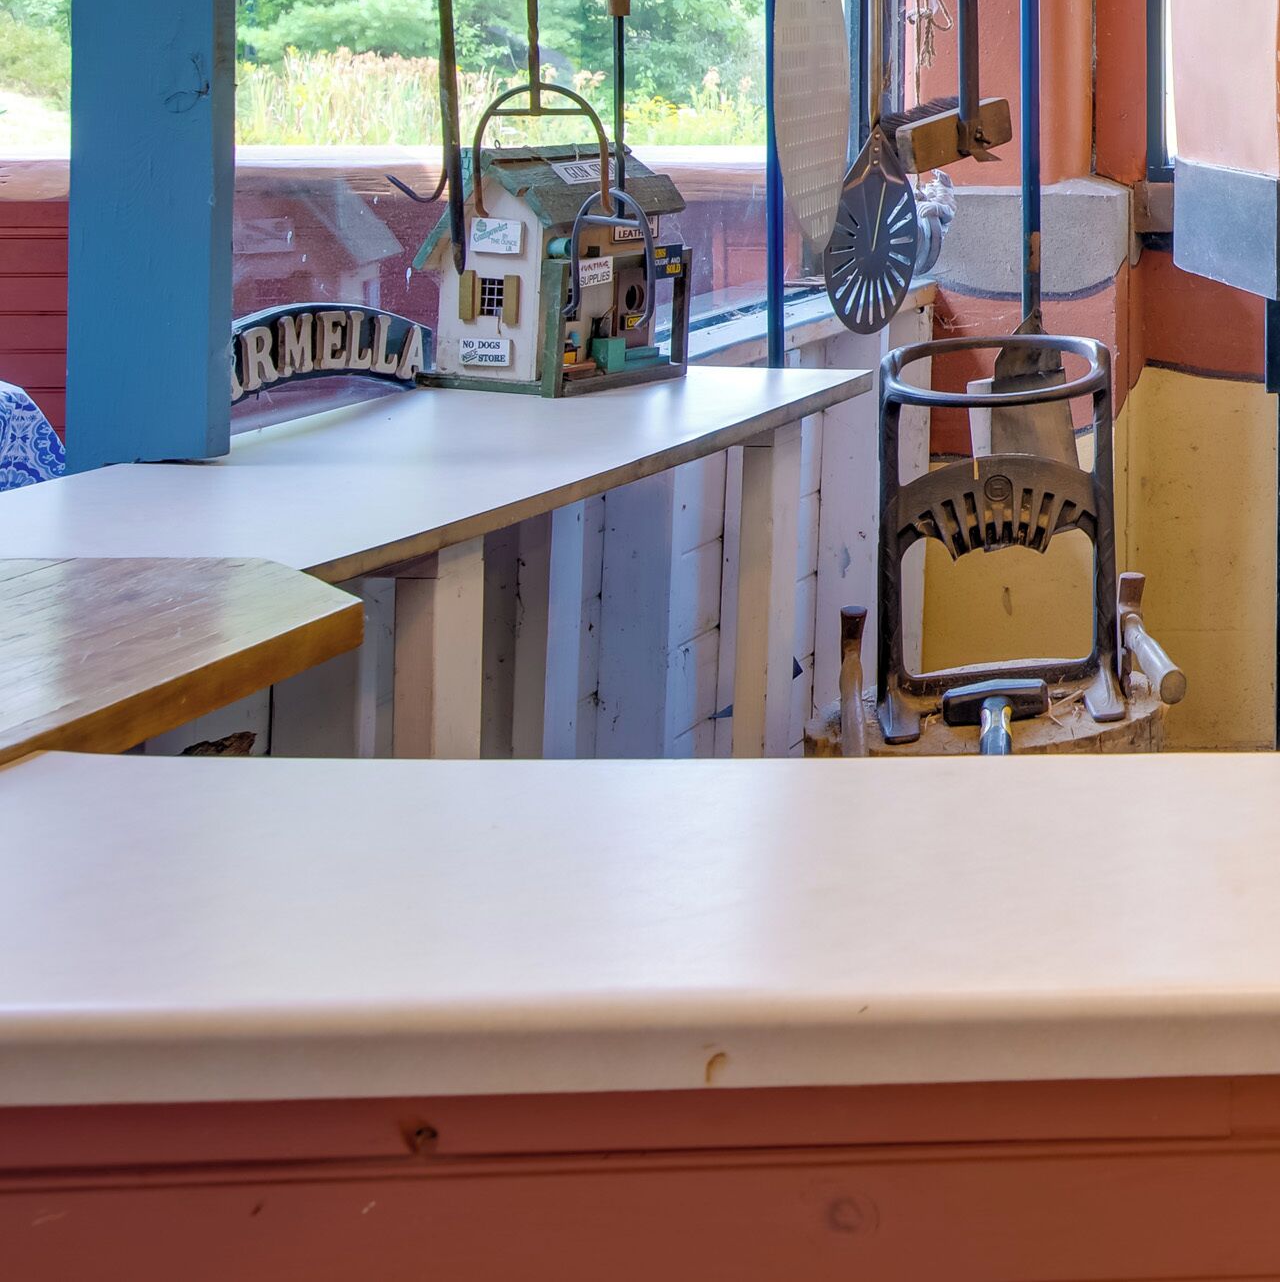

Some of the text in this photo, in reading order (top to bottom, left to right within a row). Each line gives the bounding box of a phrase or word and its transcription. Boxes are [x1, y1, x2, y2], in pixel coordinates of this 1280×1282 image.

[563, 165, 592, 179] GUN
[618, 227, 655, 239] LEATH
[580, 270, 611, 286] SUPPLIES
[462, 340, 501, 350] NO DOGS
[478, 354, 506, 363] STORE
